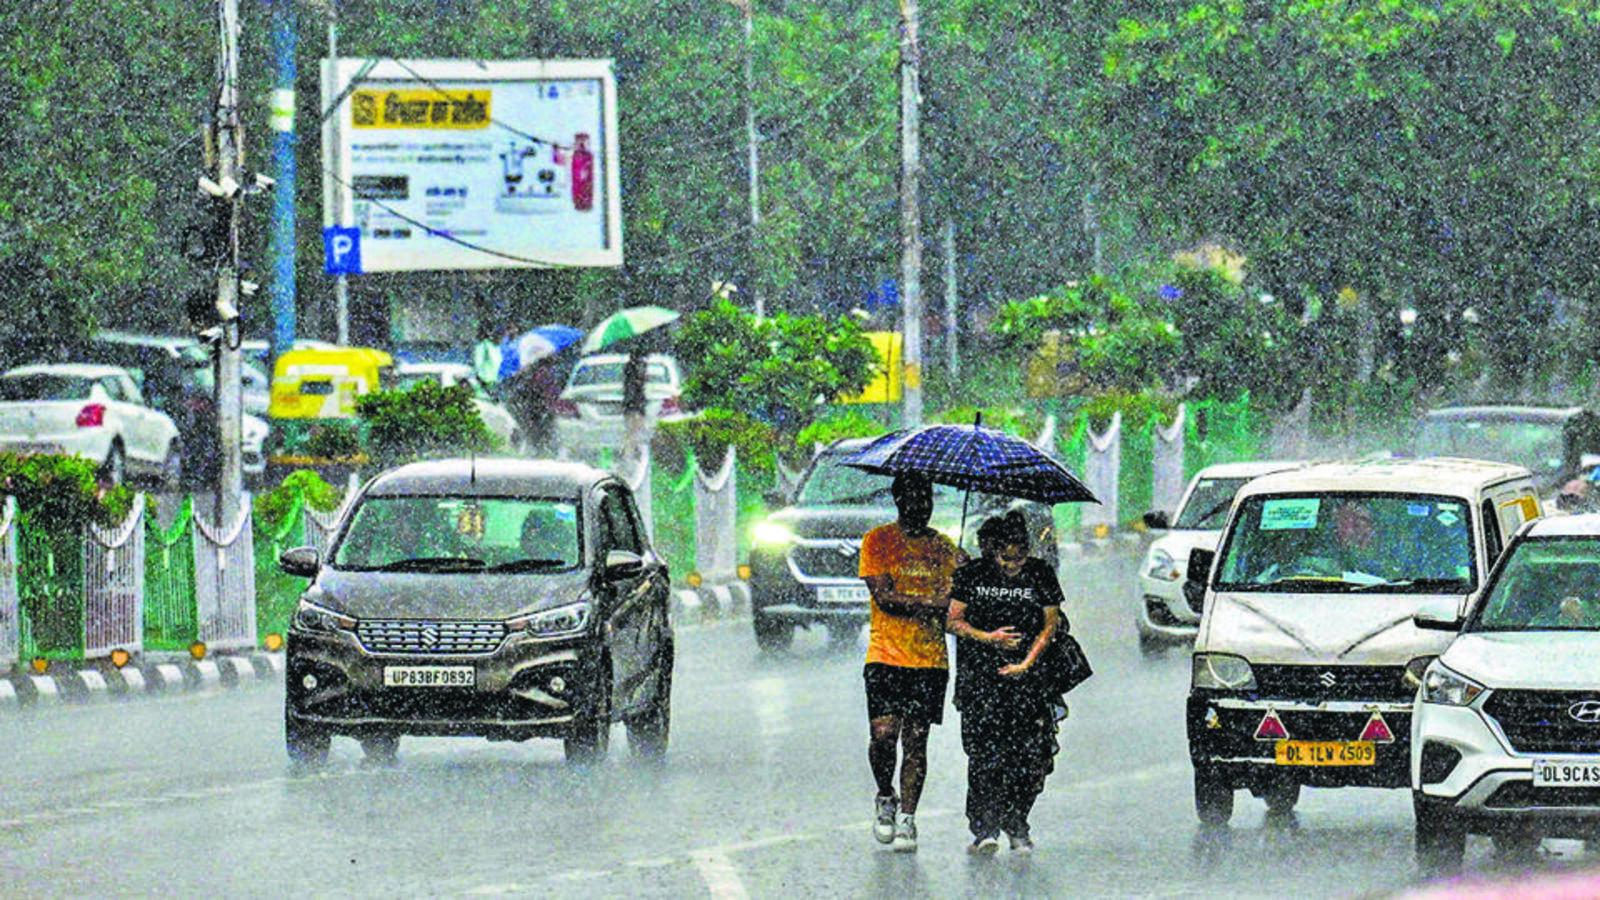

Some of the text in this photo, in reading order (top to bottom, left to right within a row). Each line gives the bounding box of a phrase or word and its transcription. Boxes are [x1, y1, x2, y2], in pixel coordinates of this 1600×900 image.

[333, 235, 352, 262] P
[976, 585, 1035, 599] INSPIRE
[1286, 745, 1303, 761] DL
[1339, 745, 1373, 761] 4509
[1542, 766, 1600, 782] DL9CAS
